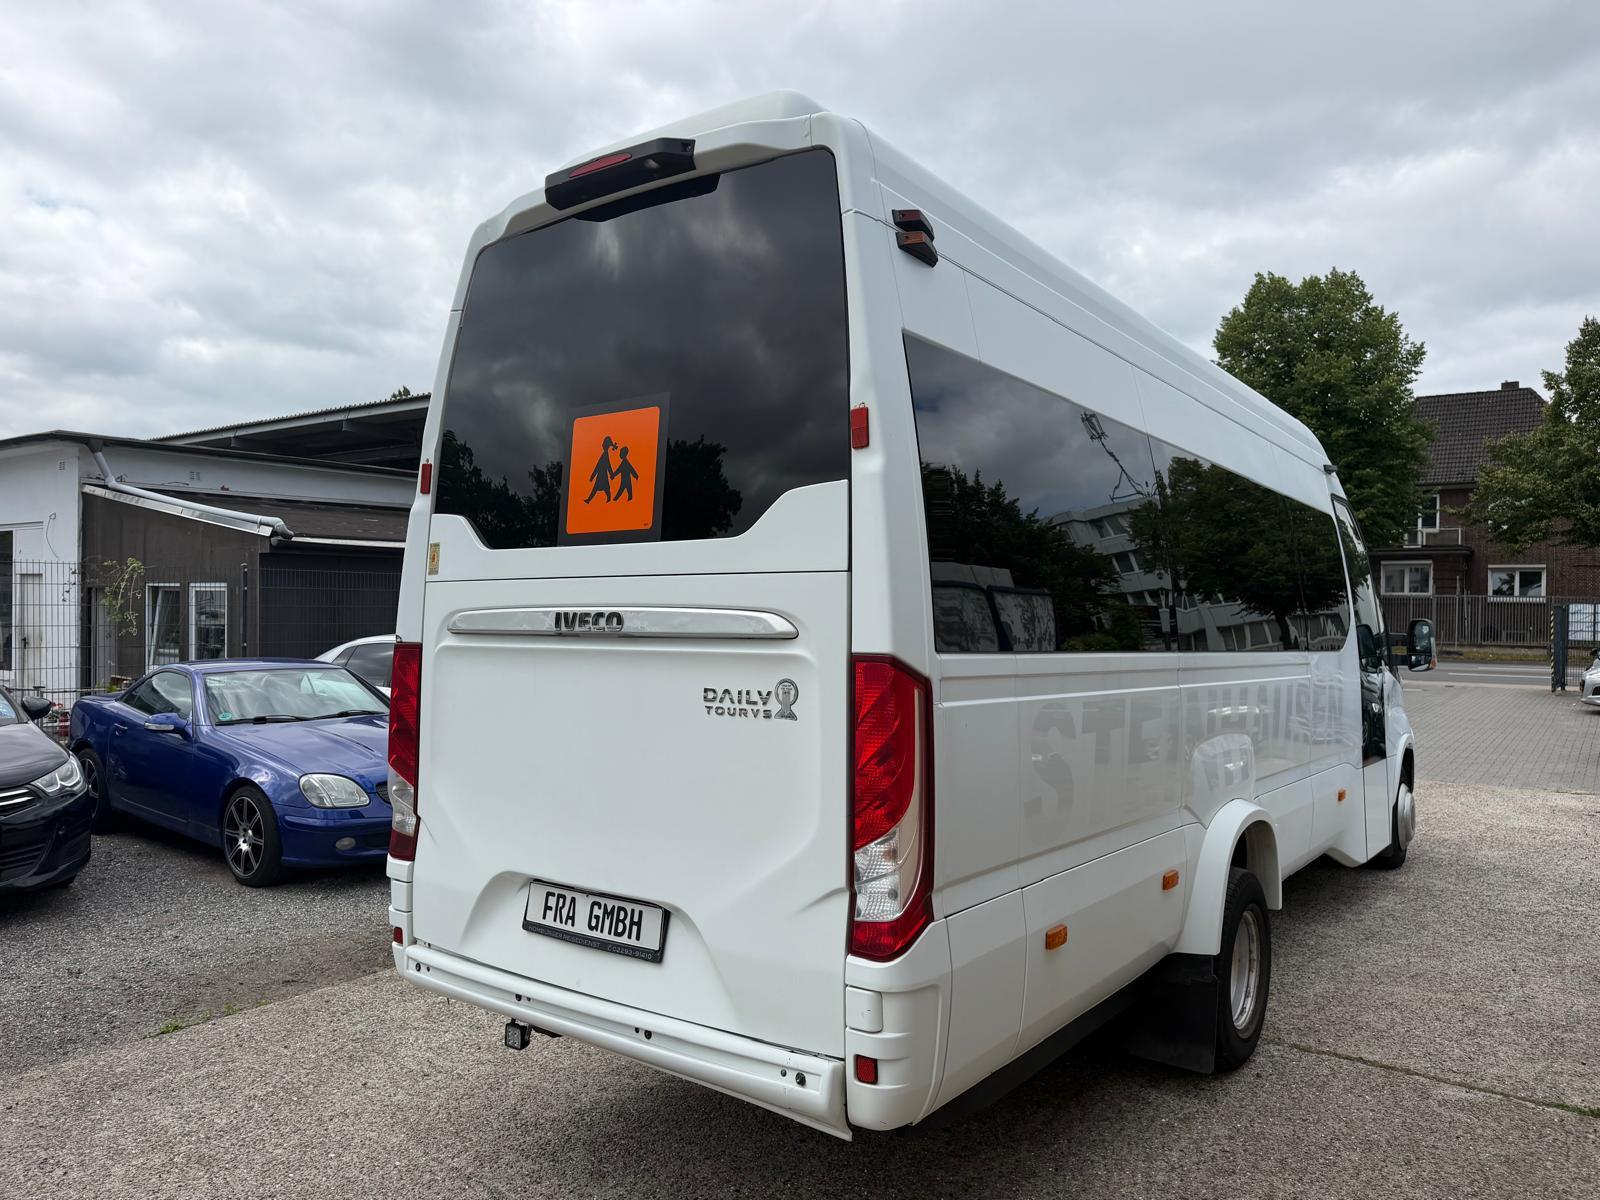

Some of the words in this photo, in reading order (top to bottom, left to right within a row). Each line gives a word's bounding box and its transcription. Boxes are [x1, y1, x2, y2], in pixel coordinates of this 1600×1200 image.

[554, 611, 624, 632] IVECO
[703, 687, 772, 706] DAILY
[542, 890, 577, 927] FRA
[588, 900, 643, 941] GMBH
